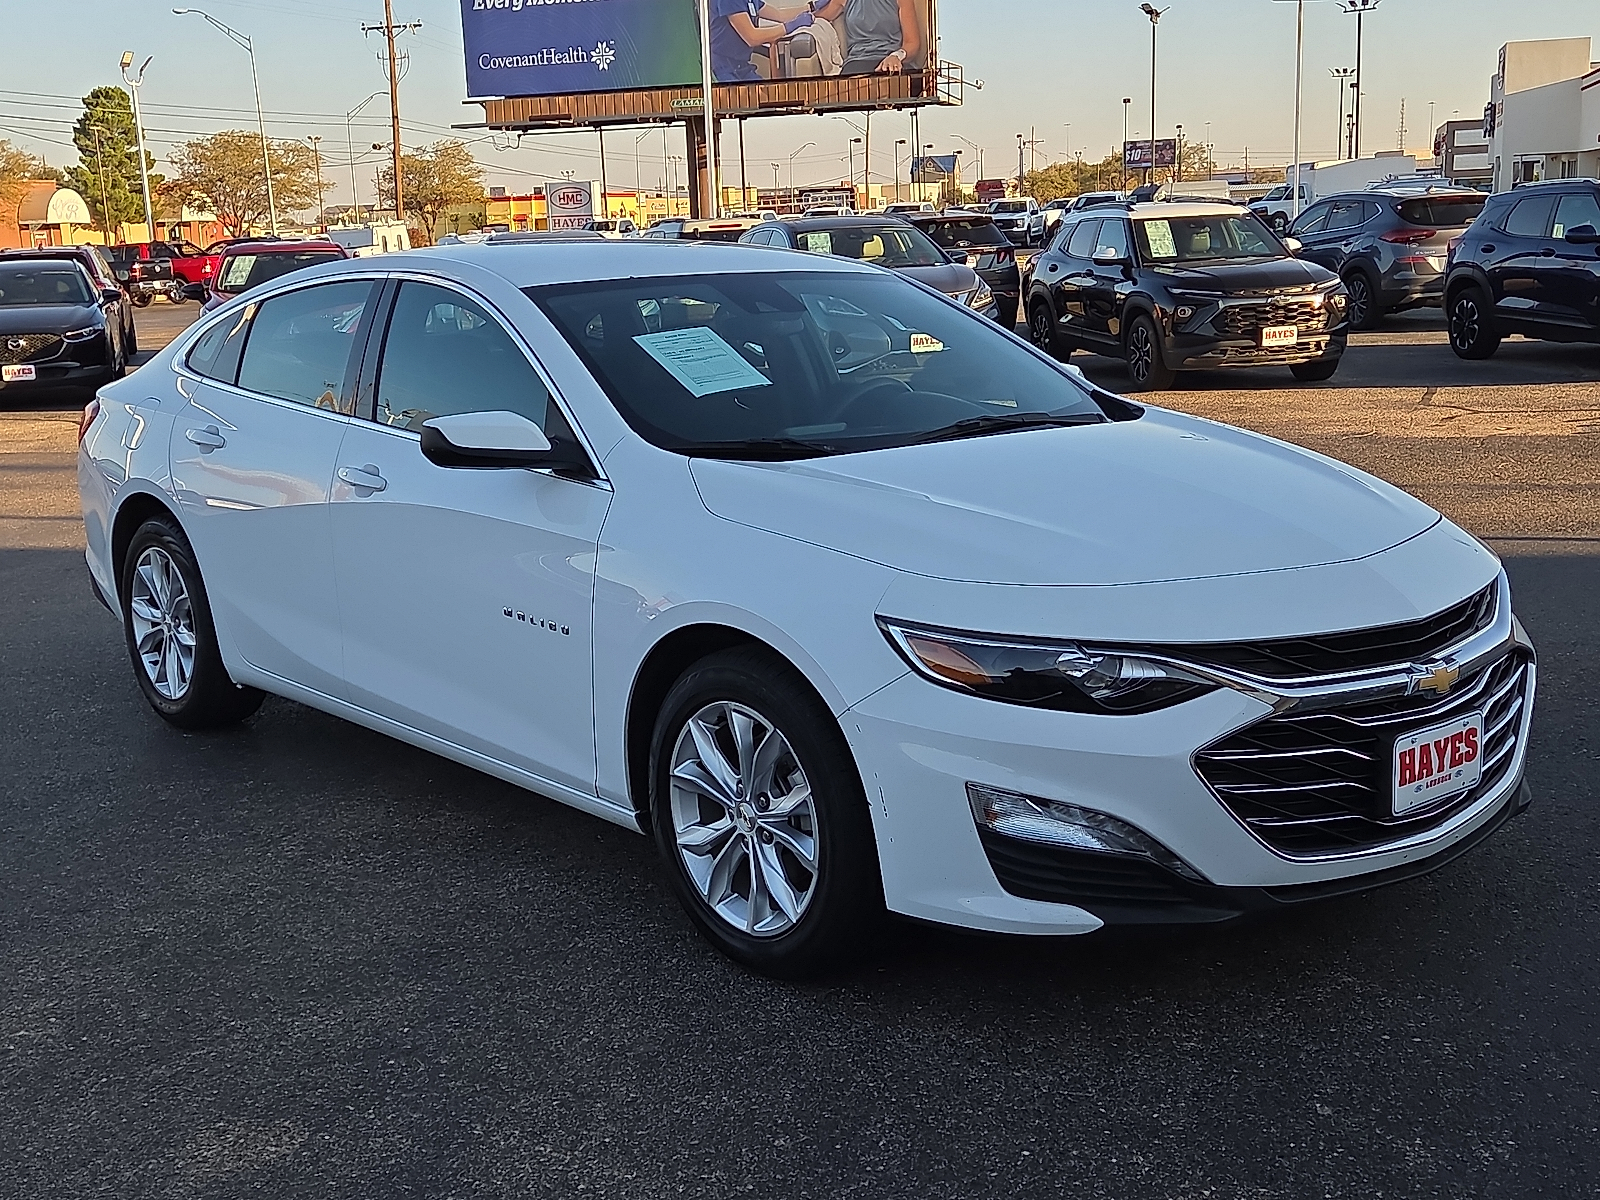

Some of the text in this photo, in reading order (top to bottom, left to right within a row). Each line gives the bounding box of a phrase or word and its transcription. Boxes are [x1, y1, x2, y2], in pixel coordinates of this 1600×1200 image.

[912, 337, 941, 346] HAYE
[1265, 330, 1294, 339] HAYES
[502, 606, 570, 635] MALIBU
[1398, 727, 1479, 788] HAYES
